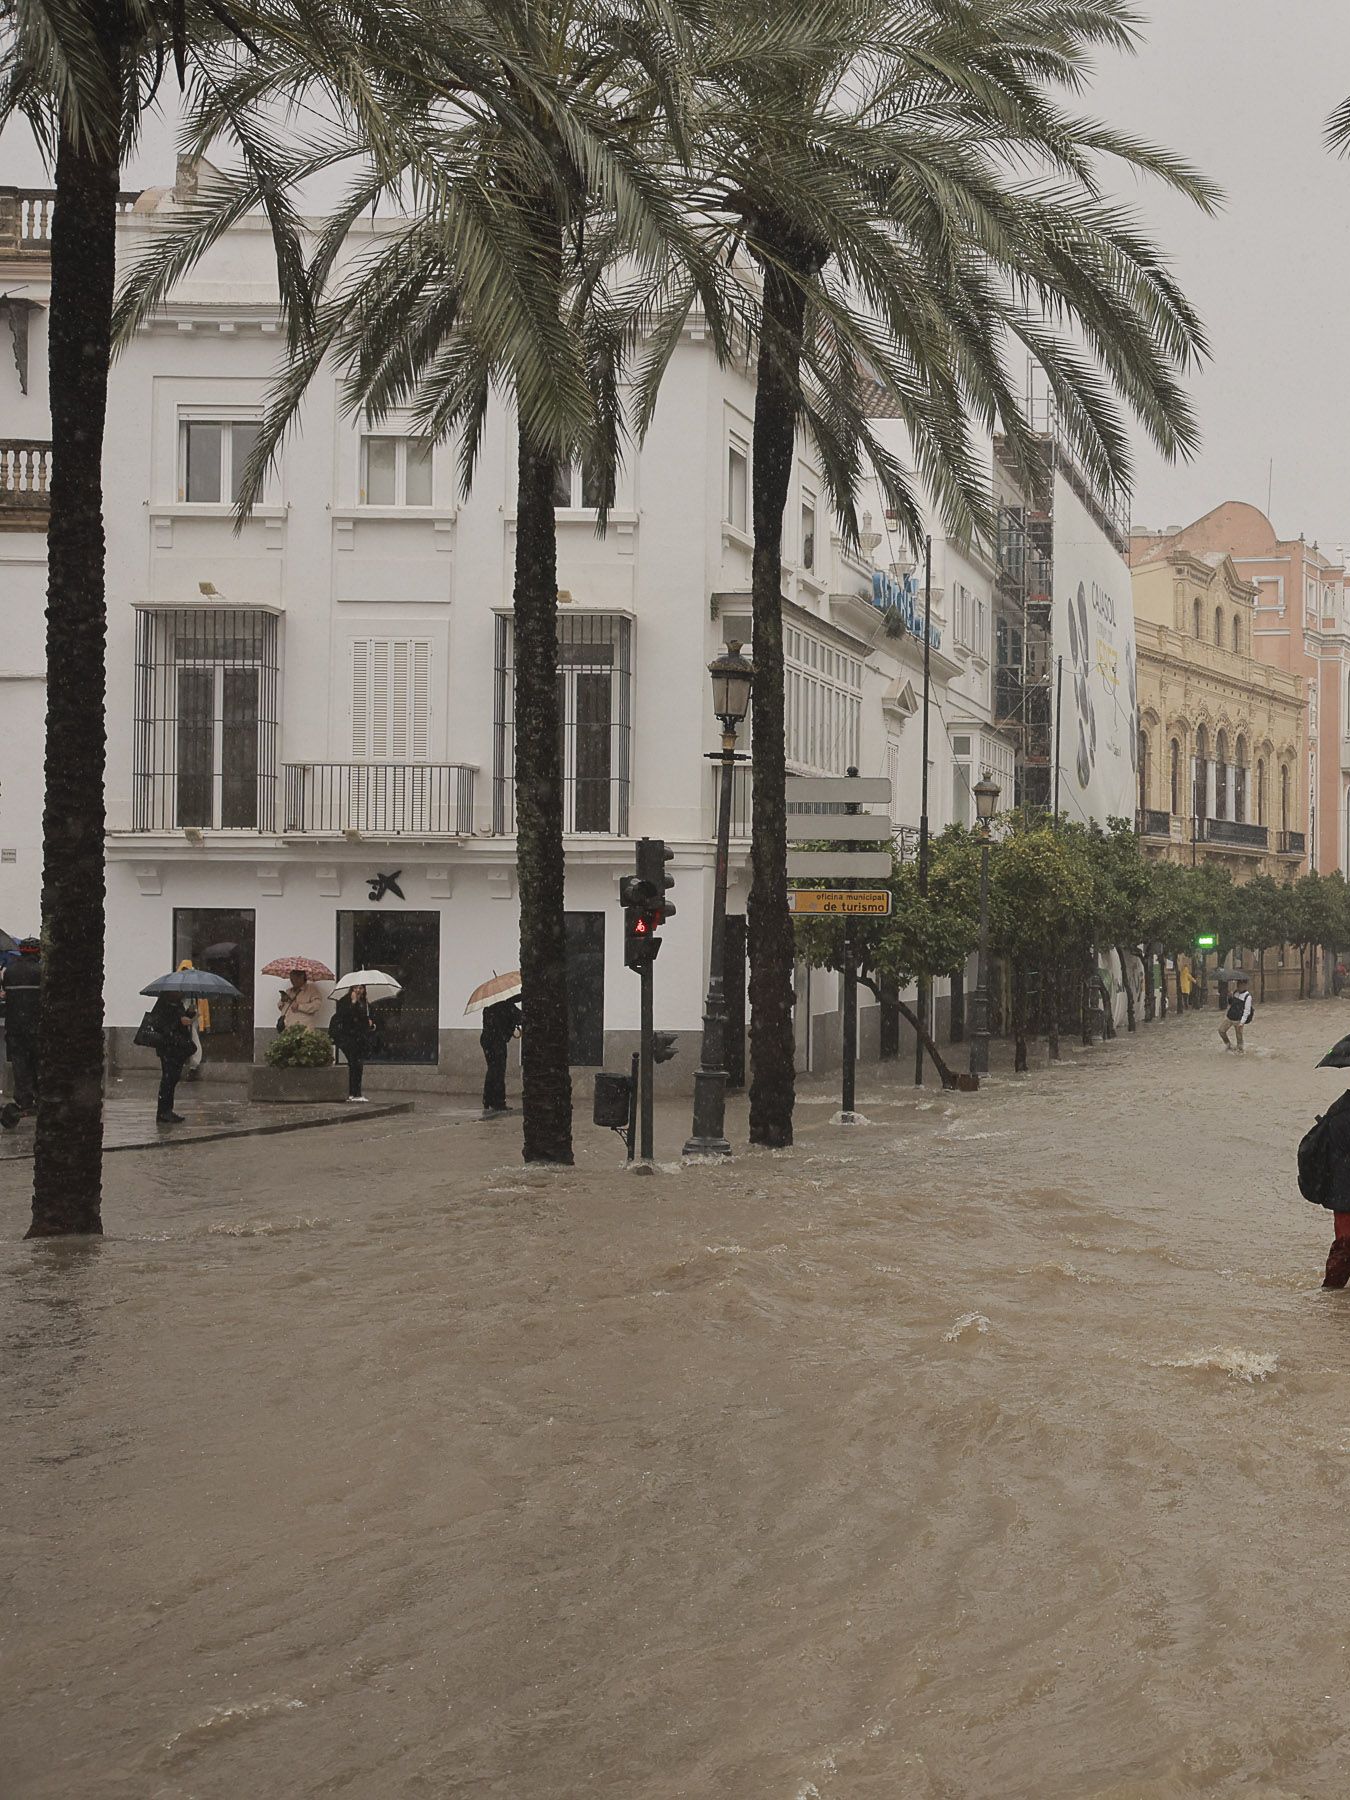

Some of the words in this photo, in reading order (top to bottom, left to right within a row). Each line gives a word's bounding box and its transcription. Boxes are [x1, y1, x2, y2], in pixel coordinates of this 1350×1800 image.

[816, 892, 843, 901] oficina
[846, 893, 885, 901] municipal
[823, 902, 837, 912] de
[841, 902, 885, 912] turismo
